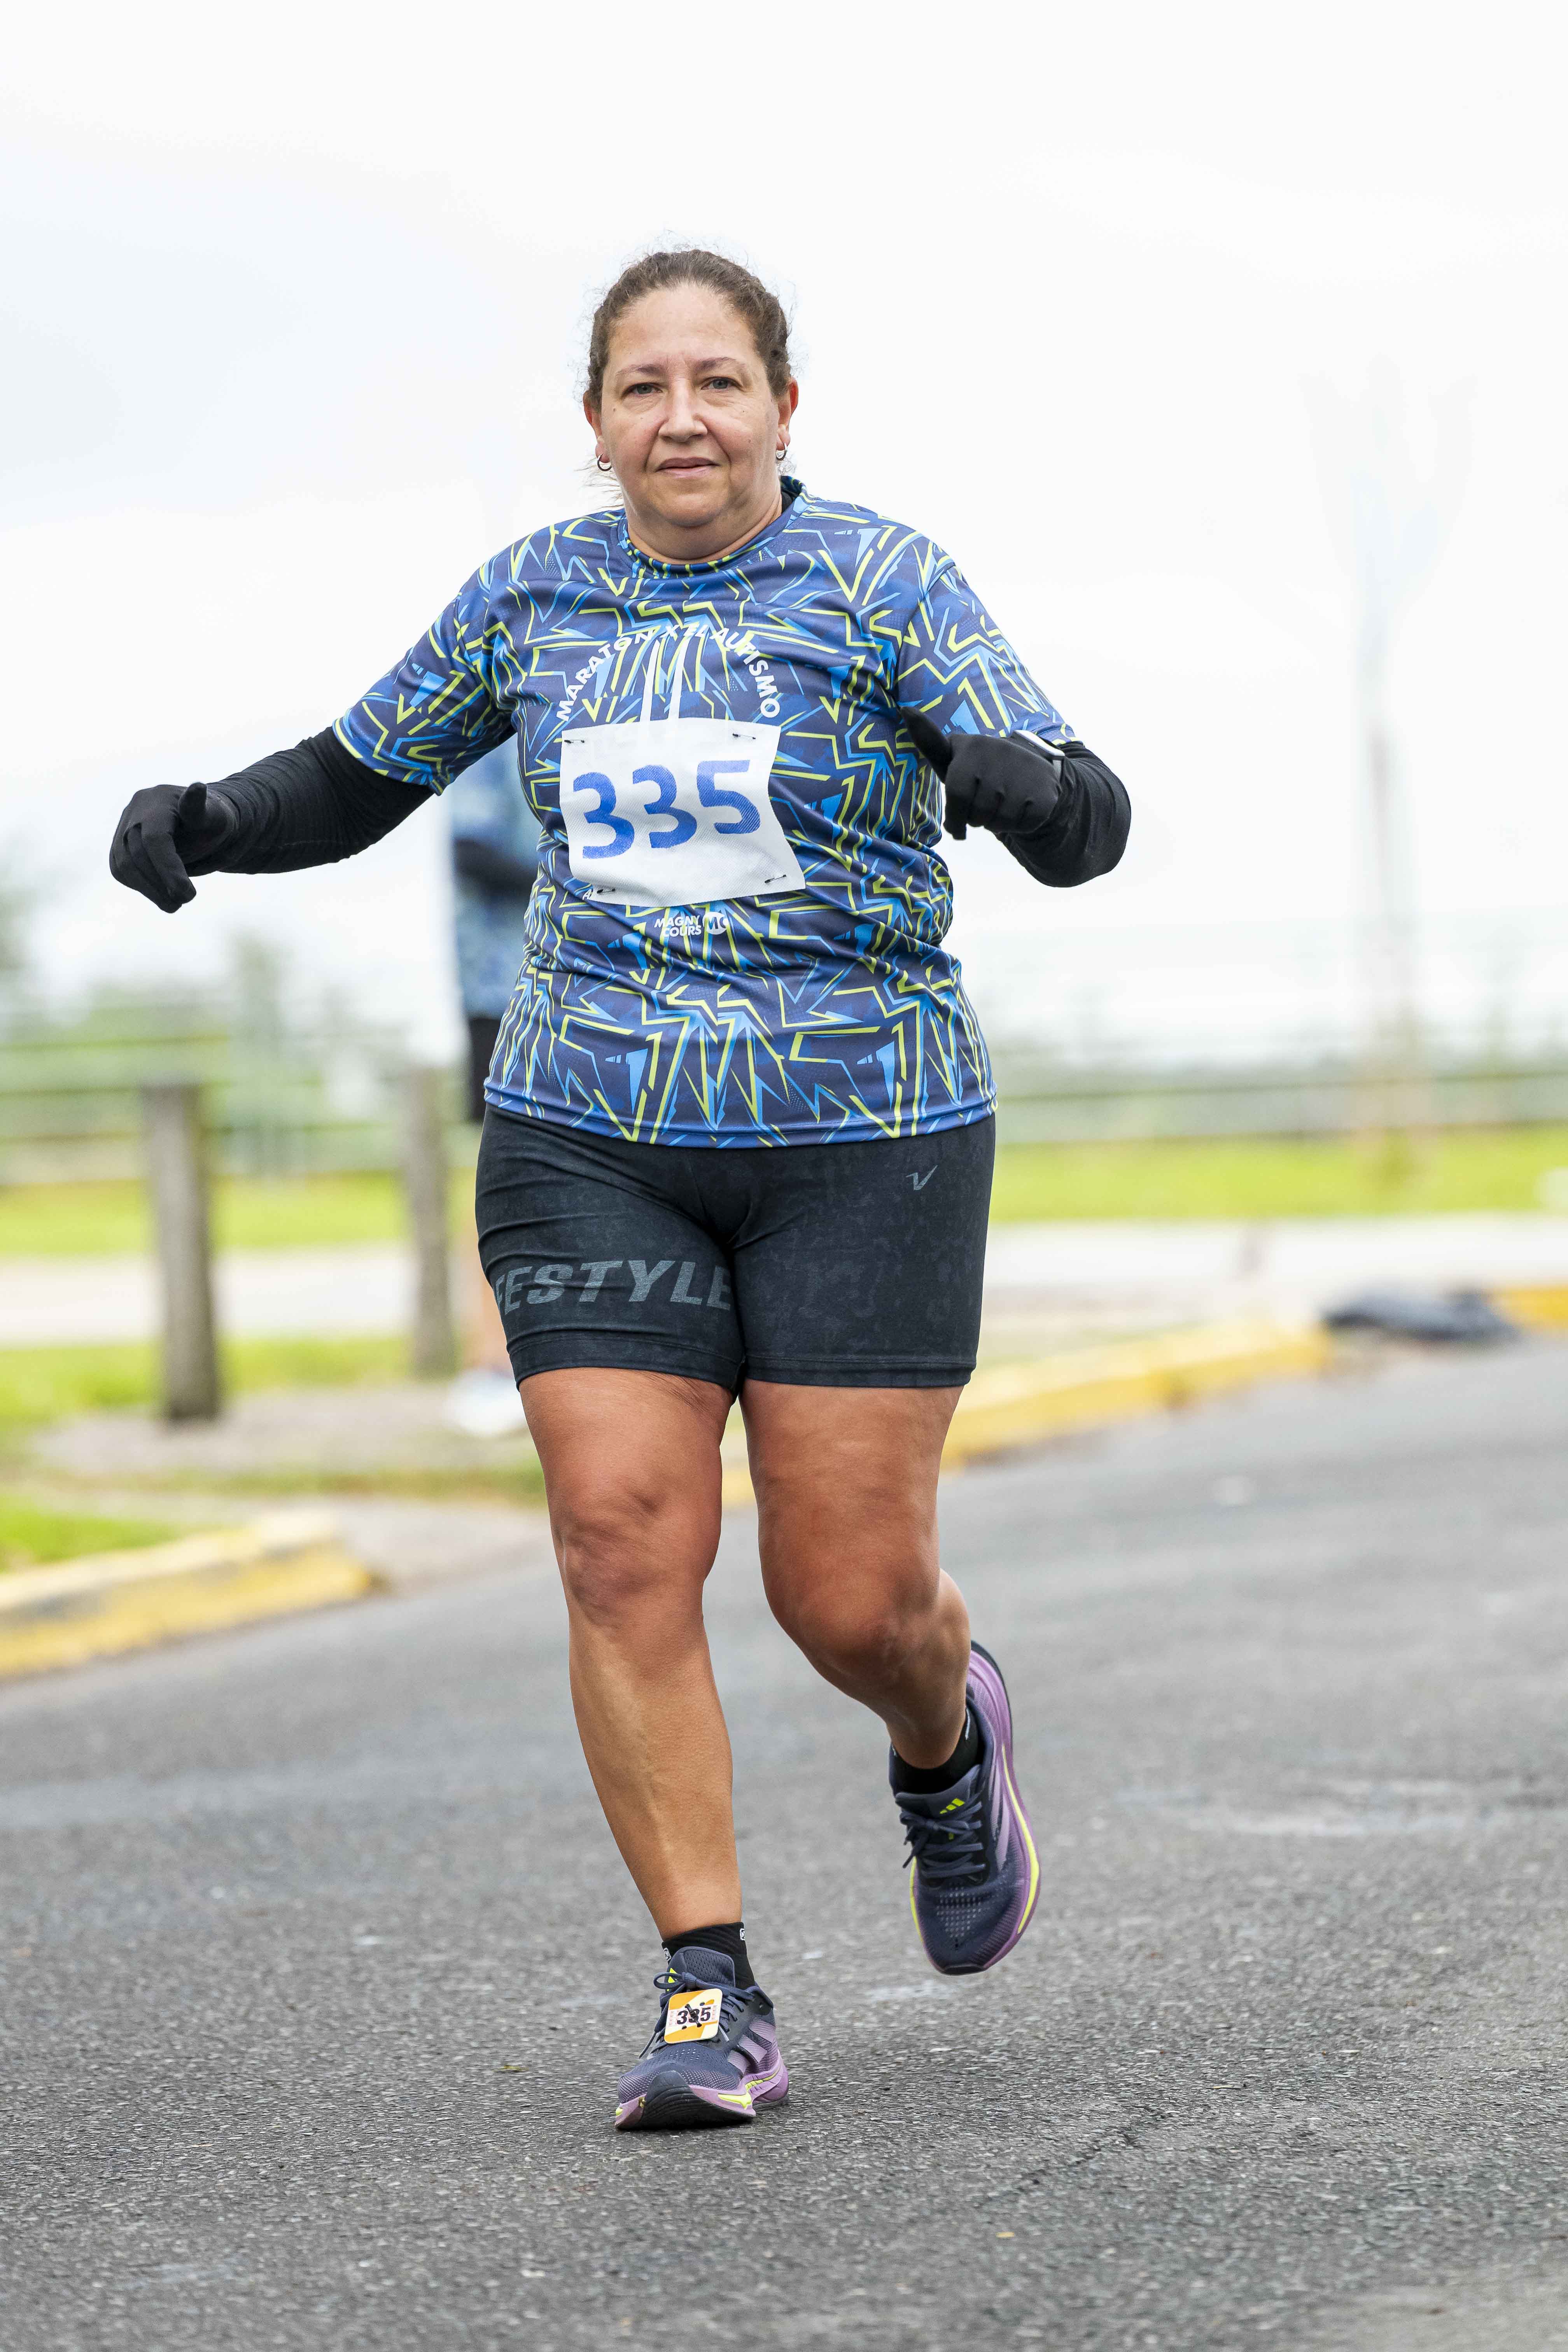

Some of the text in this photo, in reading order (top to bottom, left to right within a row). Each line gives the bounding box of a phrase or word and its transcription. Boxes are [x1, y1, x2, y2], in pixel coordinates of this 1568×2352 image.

[660, 624, 679, 638] X
[709, 627, 780, 718] AUTISMO
[573, 759, 761, 859] 335
[653, 915, 700, 928] MAGNY
[663, 925, 702, 937] COURS
[677, 2007, 711, 2025] 335
